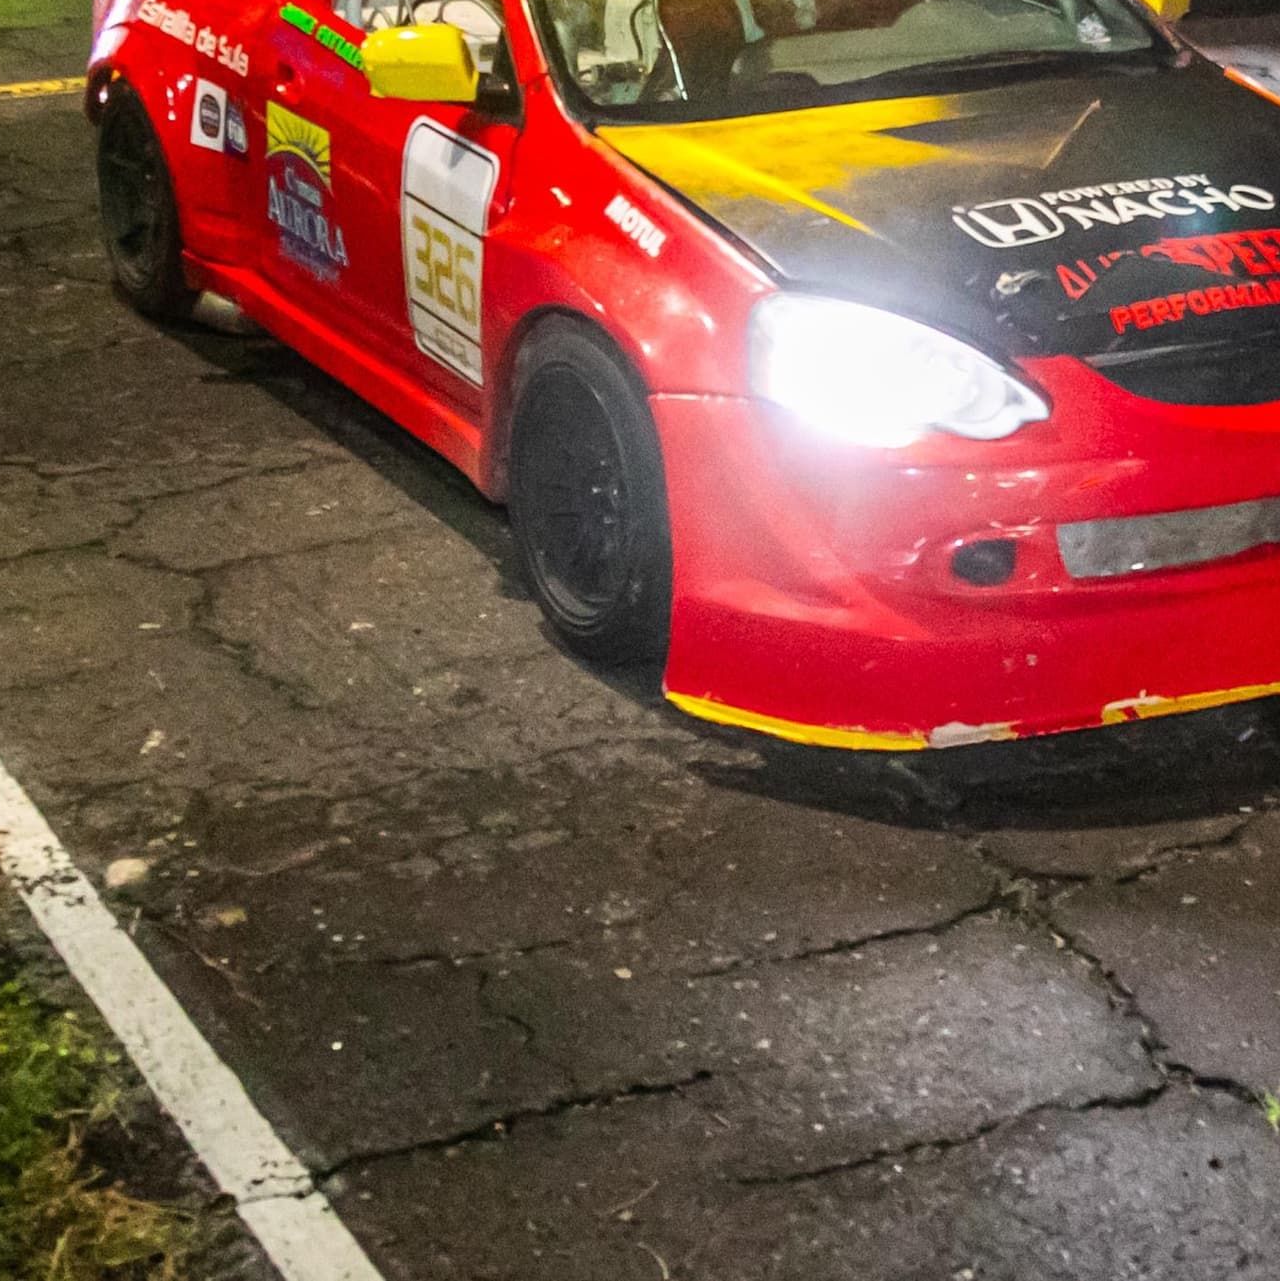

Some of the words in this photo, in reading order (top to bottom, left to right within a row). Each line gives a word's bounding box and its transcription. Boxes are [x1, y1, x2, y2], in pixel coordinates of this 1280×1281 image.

[1040, 177, 1173, 206] POWERED
[1173, 173, 1212, 191] BY
[1057, 184, 1276, 230] NACHO
[604, 194, 666, 258] MOTUL
[412, 215, 478, 326] 326
